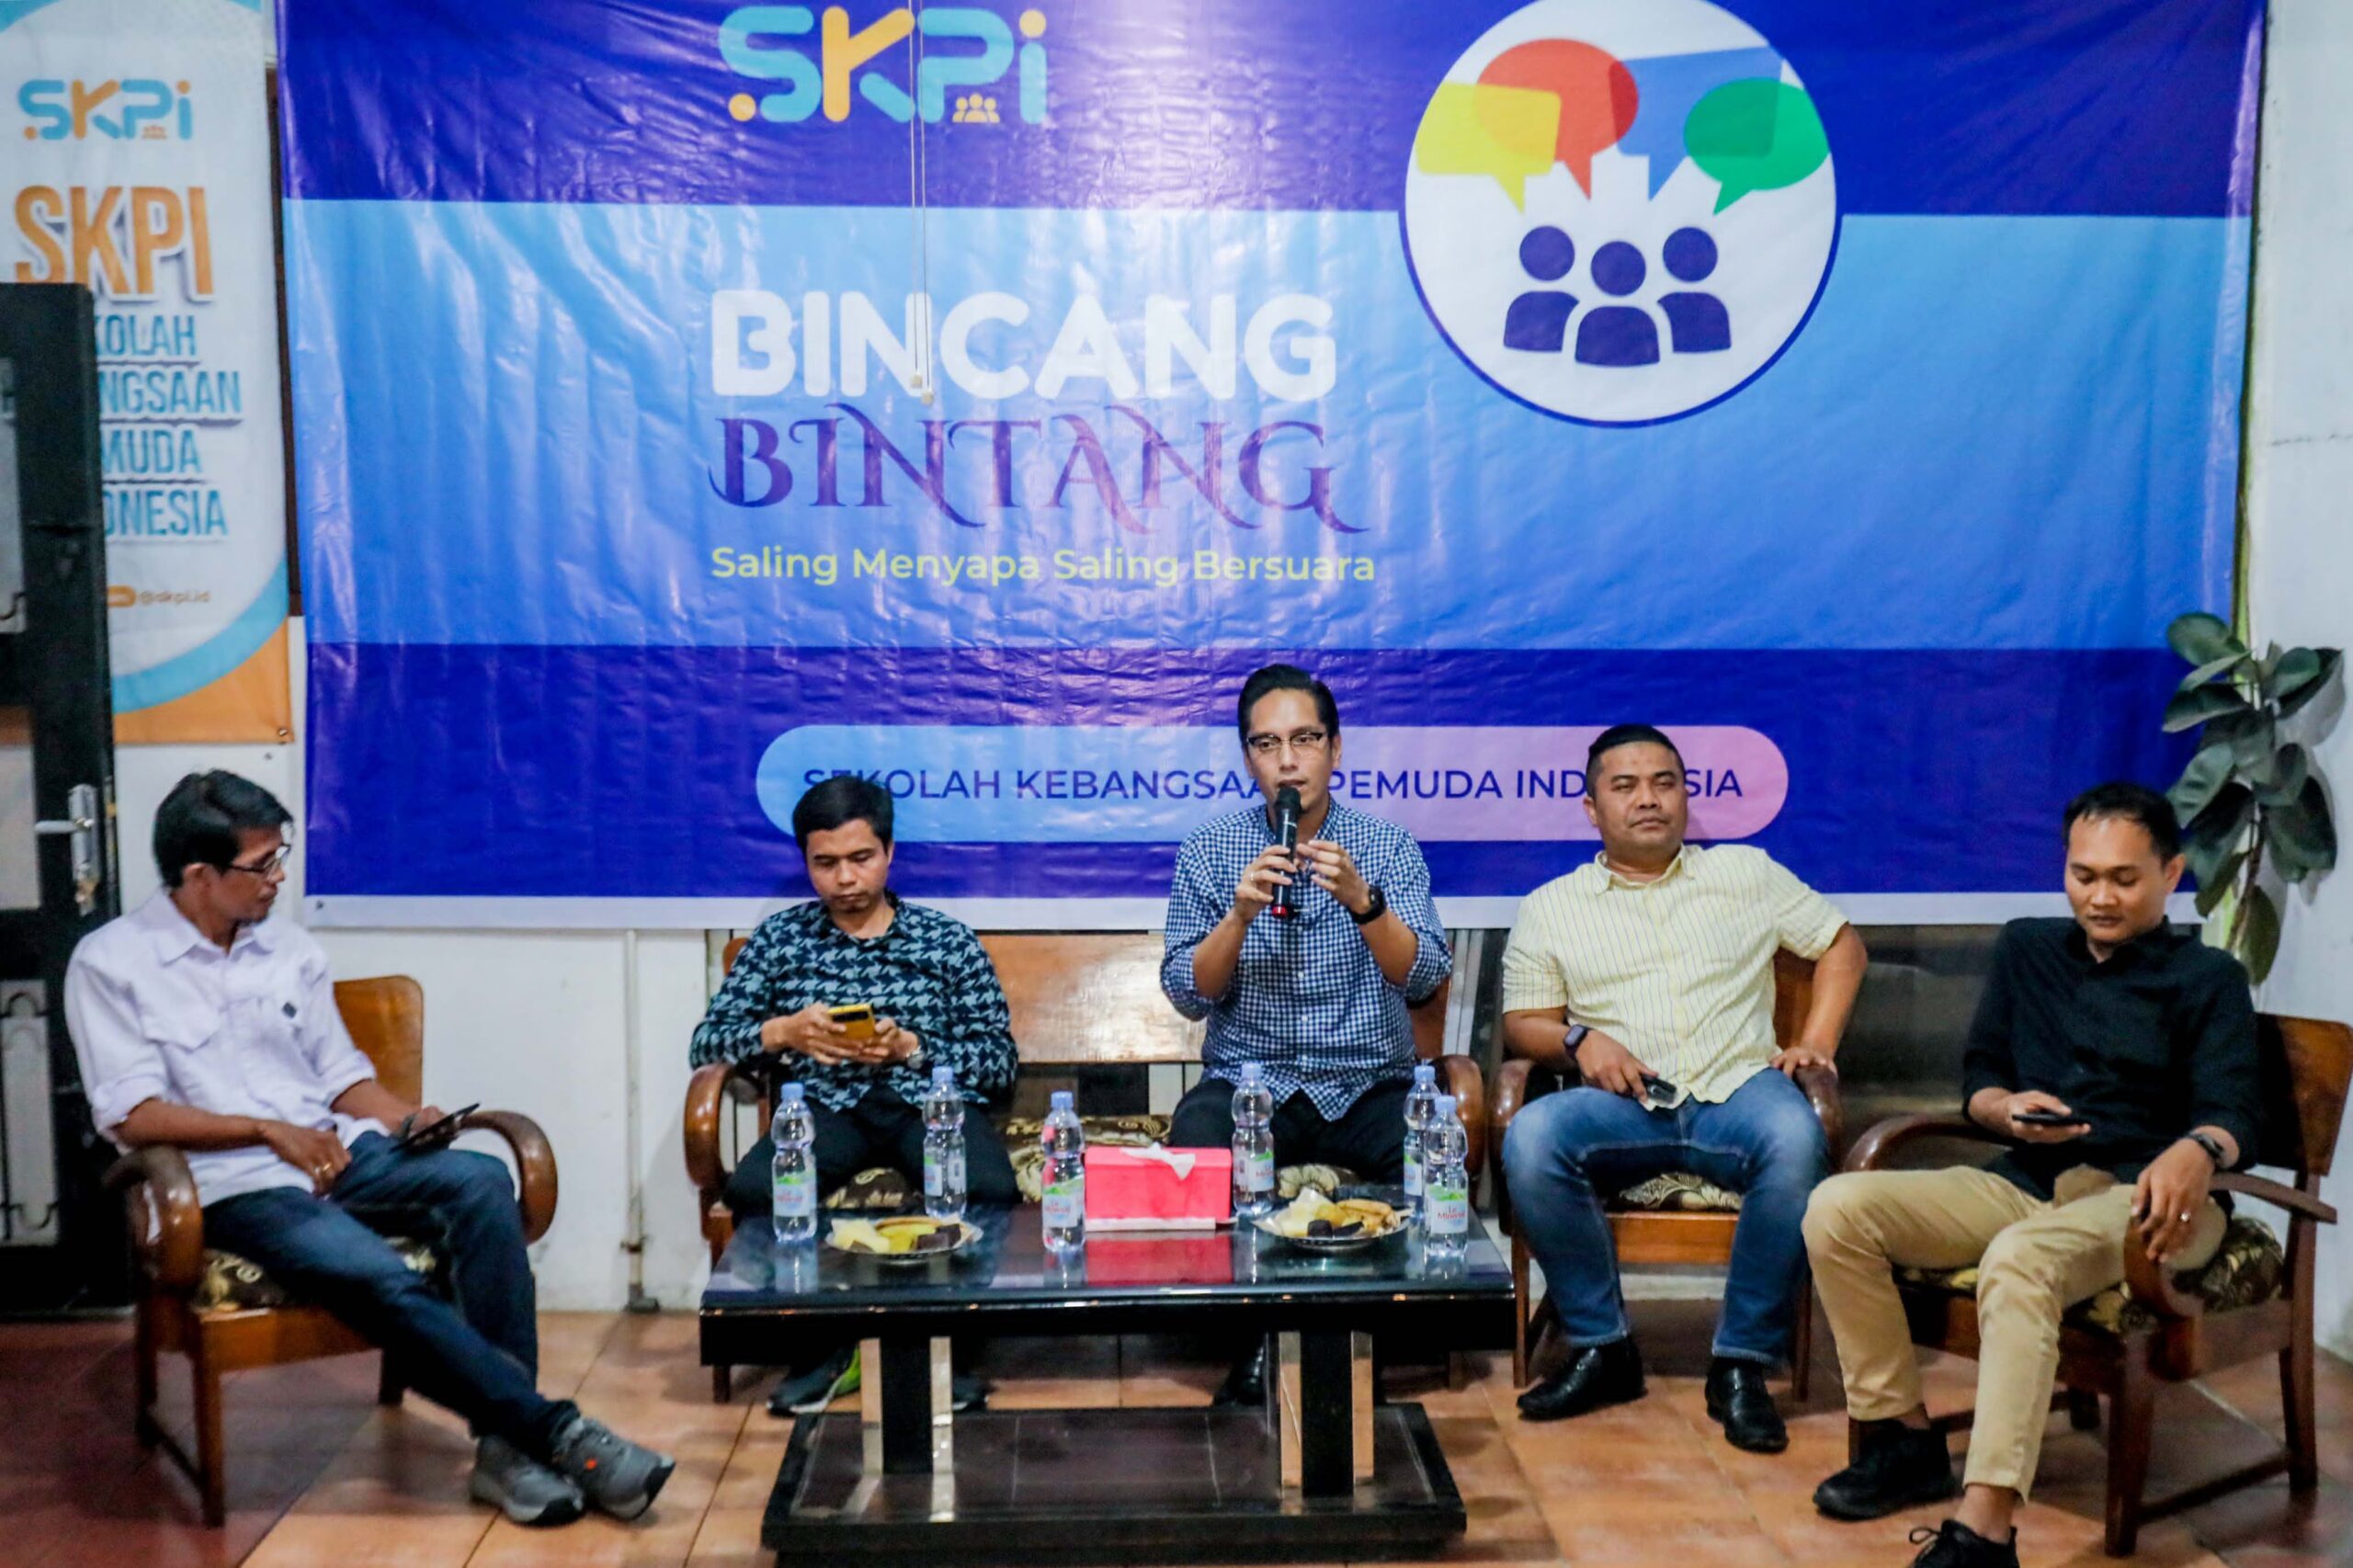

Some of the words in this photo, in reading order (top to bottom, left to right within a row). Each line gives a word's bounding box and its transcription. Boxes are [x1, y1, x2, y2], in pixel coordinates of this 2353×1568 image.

[14, 185, 215, 296] SKPI
[710, 290, 1337, 400] BINCANG
[707, 402, 1371, 535] BINTANG
[710, 545, 838, 586] Saling
[852, 548, 1040, 587] Menyapa
[1052, 547, 1180, 588] Saling
[1193, 550, 1376, 582] Bersuara
[1517, 768, 1744, 800] INDSIA
